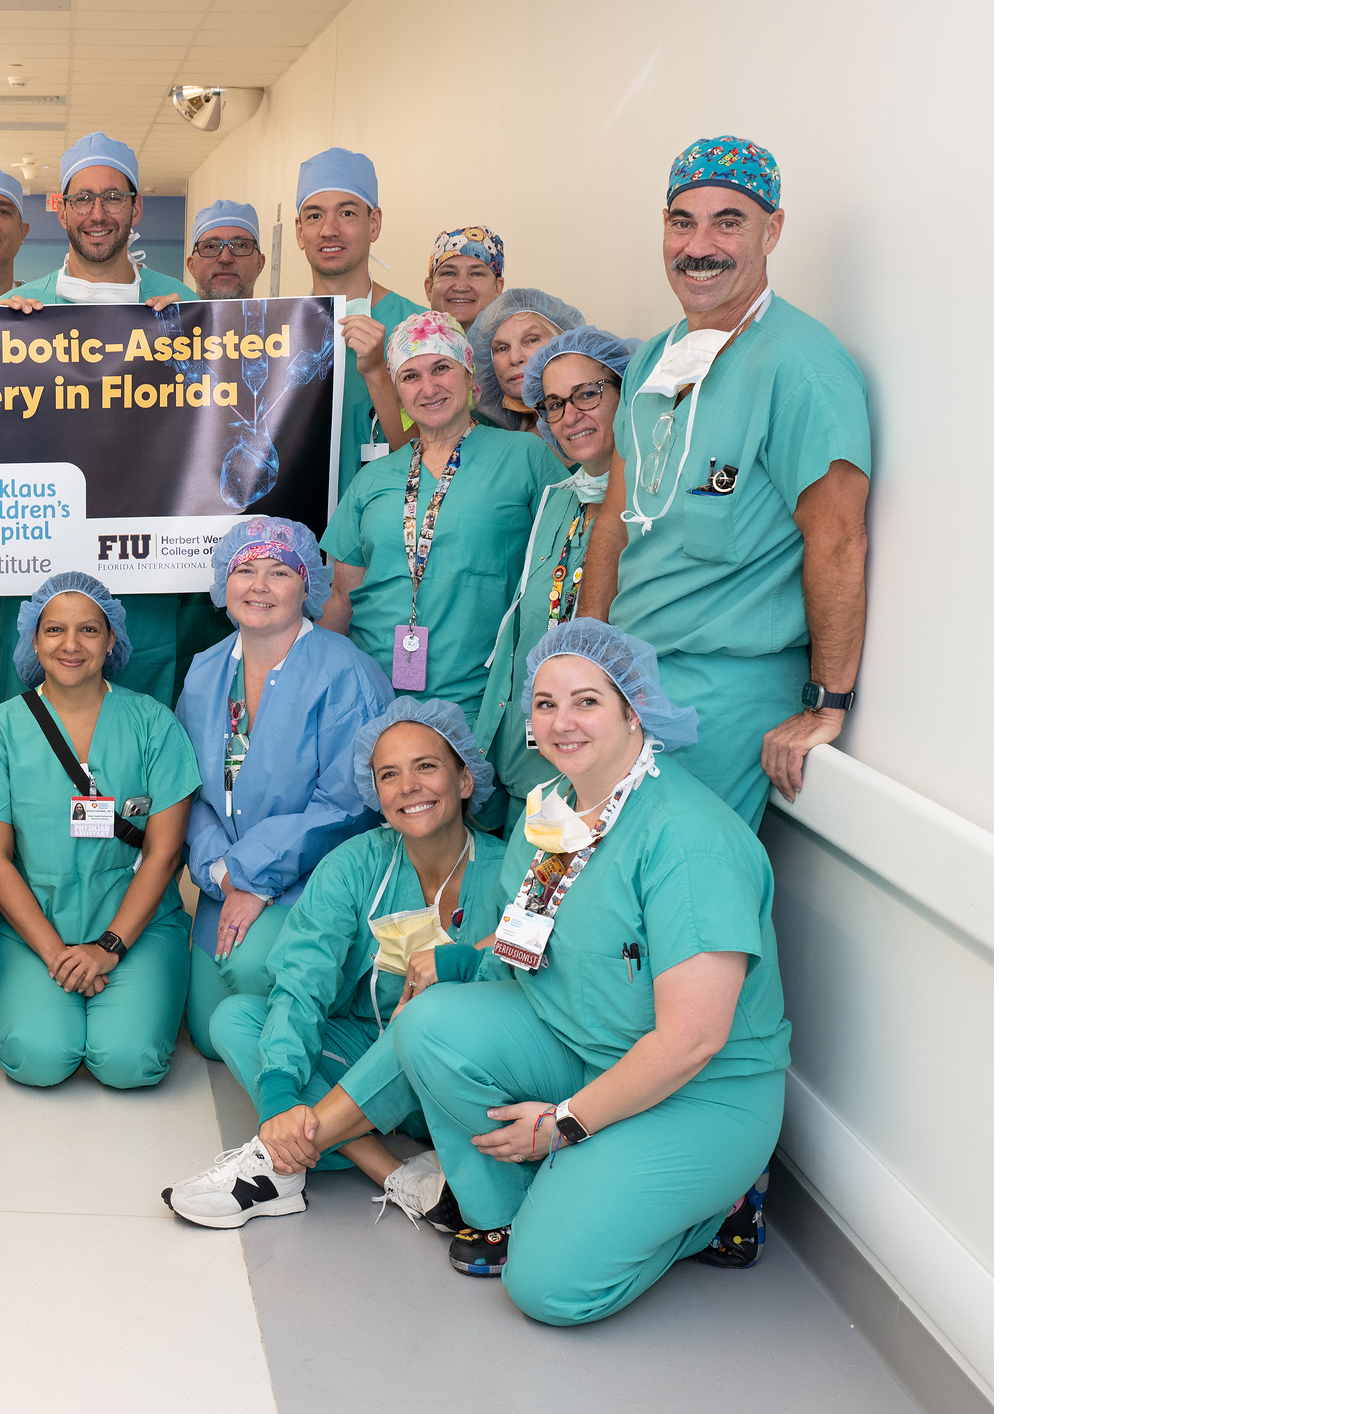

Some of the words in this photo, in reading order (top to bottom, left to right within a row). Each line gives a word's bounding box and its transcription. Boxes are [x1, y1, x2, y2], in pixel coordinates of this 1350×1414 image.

[54, 375, 90, 410] in
[101, 374, 238, 409] Florida
[161, 535, 201, 545] Herbert
[98, 533, 152, 560] FIU
[161, 547, 201, 558] College
[202, 546, 214, 556] of
[97, 562, 135, 571] FLORIDA
[137, 561, 208, 571] INTERNATIONAL
[74, 824, 110, 832] PHYSICIAN
[495, 942, 538, 965] PERFUSIONIST
